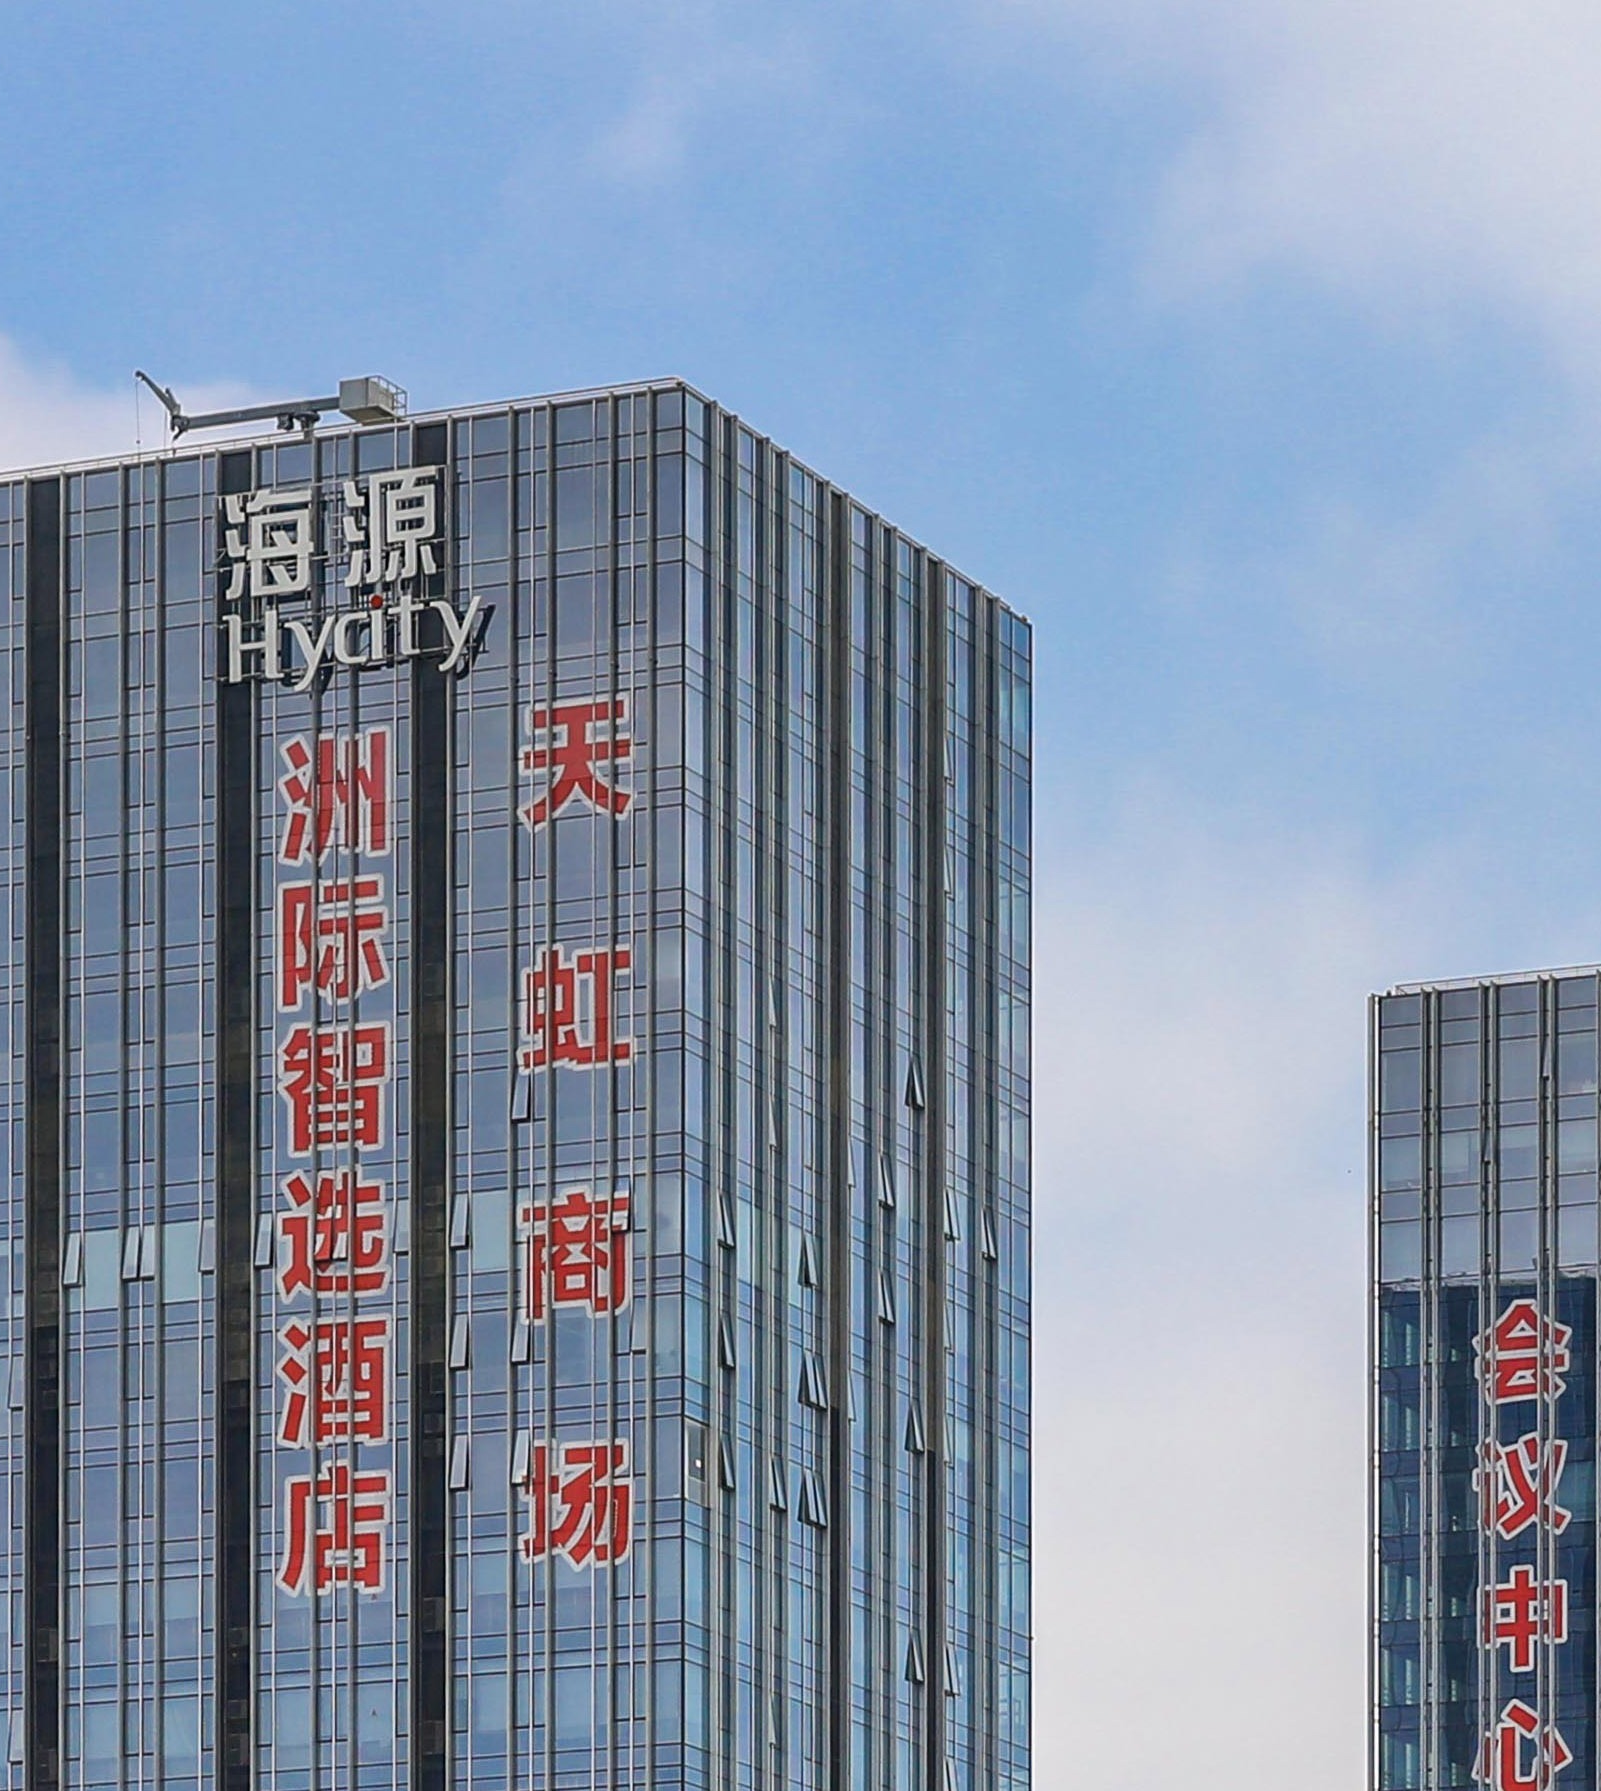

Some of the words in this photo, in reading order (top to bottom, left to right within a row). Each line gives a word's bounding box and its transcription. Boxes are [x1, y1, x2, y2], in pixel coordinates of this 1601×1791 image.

[221, 594, 482, 692] Hycity
[223, 464, 446, 600] 海源
[276, 725, 394, 1598] 洲际智选酒店
[517, 693, 638, 1573] 天虹商场
